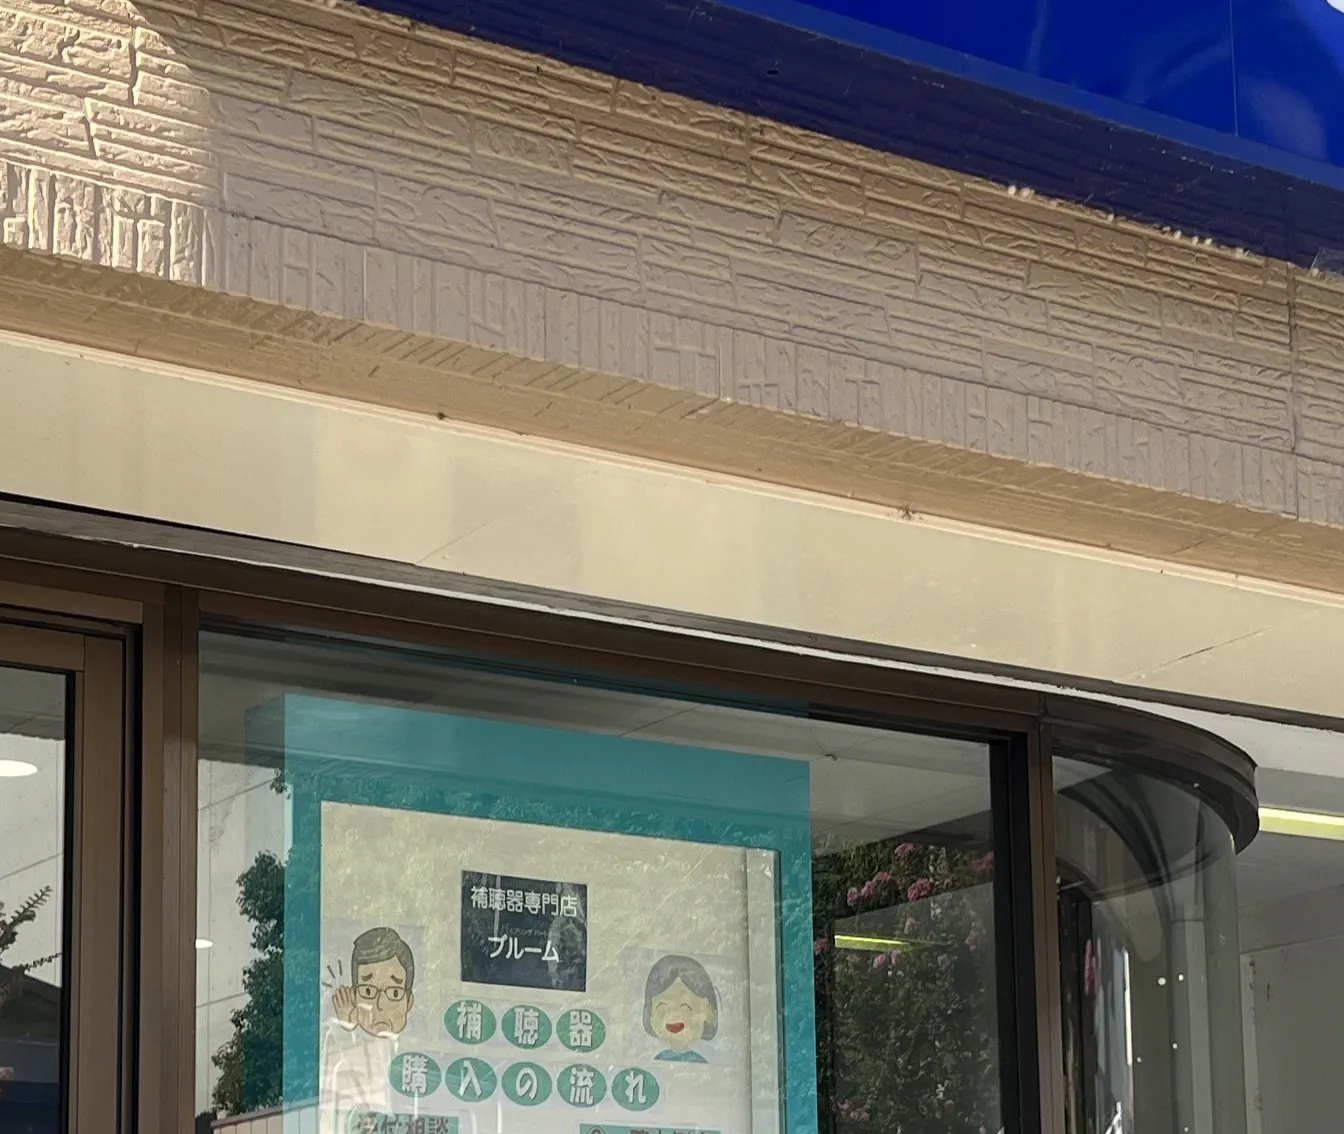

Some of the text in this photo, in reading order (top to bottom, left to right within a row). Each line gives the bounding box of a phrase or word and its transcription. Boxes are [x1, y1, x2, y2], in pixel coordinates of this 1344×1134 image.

[471, 886, 577, 917] 補聴器専門店
[488, 934, 560, 963] ブルーム
[455, 1005, 595, 1049] 補聴器
[401, 1058, 648, 1106] 購入の流れ
